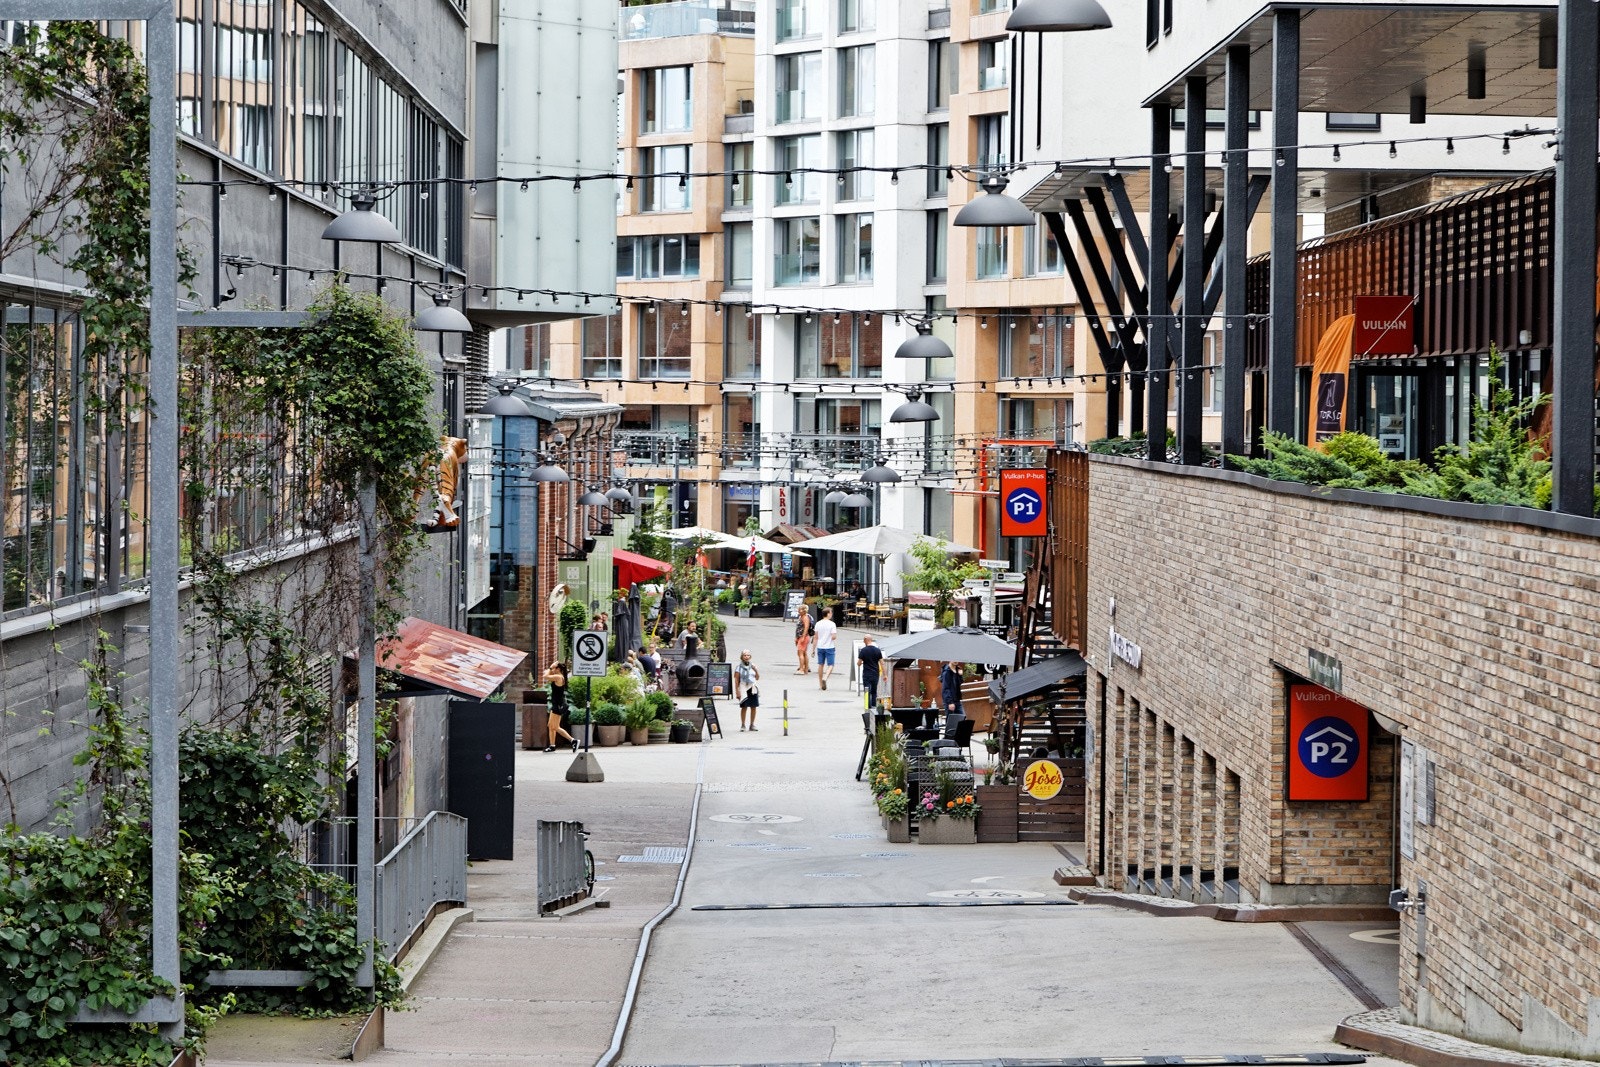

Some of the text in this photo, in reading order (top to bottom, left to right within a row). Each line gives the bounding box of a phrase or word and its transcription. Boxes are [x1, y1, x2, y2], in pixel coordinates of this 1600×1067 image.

[1362, 320, 1407, 330] VULKAN
[1320, 409, 1342, 421] TORSO
[1013, 502, 1036, 515] P1
[1295, 691, 1331, 701] Vulkan
[1311, 741, 1348, 764] P2
[1025, 770, 1062, 791] Jose's
